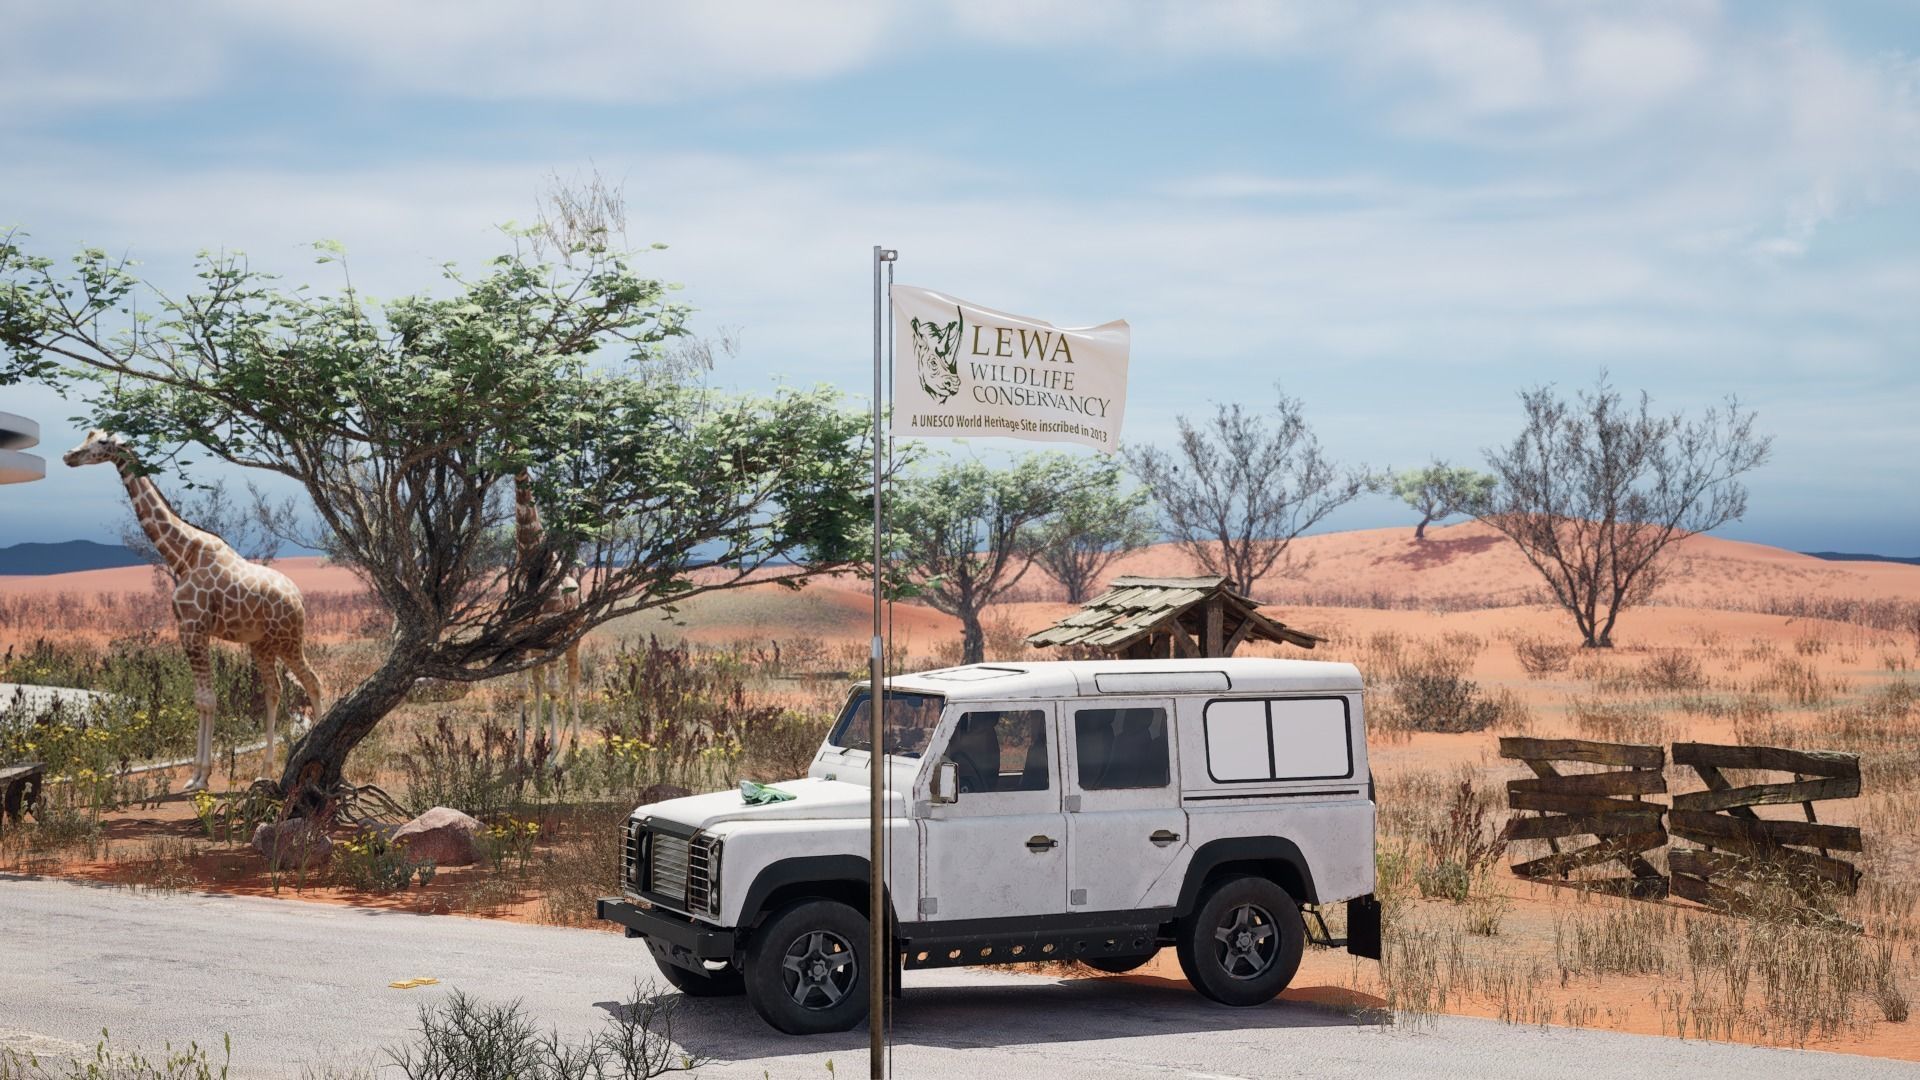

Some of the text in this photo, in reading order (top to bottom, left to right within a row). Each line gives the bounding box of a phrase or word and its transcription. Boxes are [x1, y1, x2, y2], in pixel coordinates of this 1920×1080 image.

[972, 325, 1075, 364] LEWA
[970, 362, 1075, 391] WILDLIFE
[973, 385, 1111, 418] CONSERVANCY
[911, 414, 1107, 443] A UNESCO World Heritage Site inscribed in 2013
